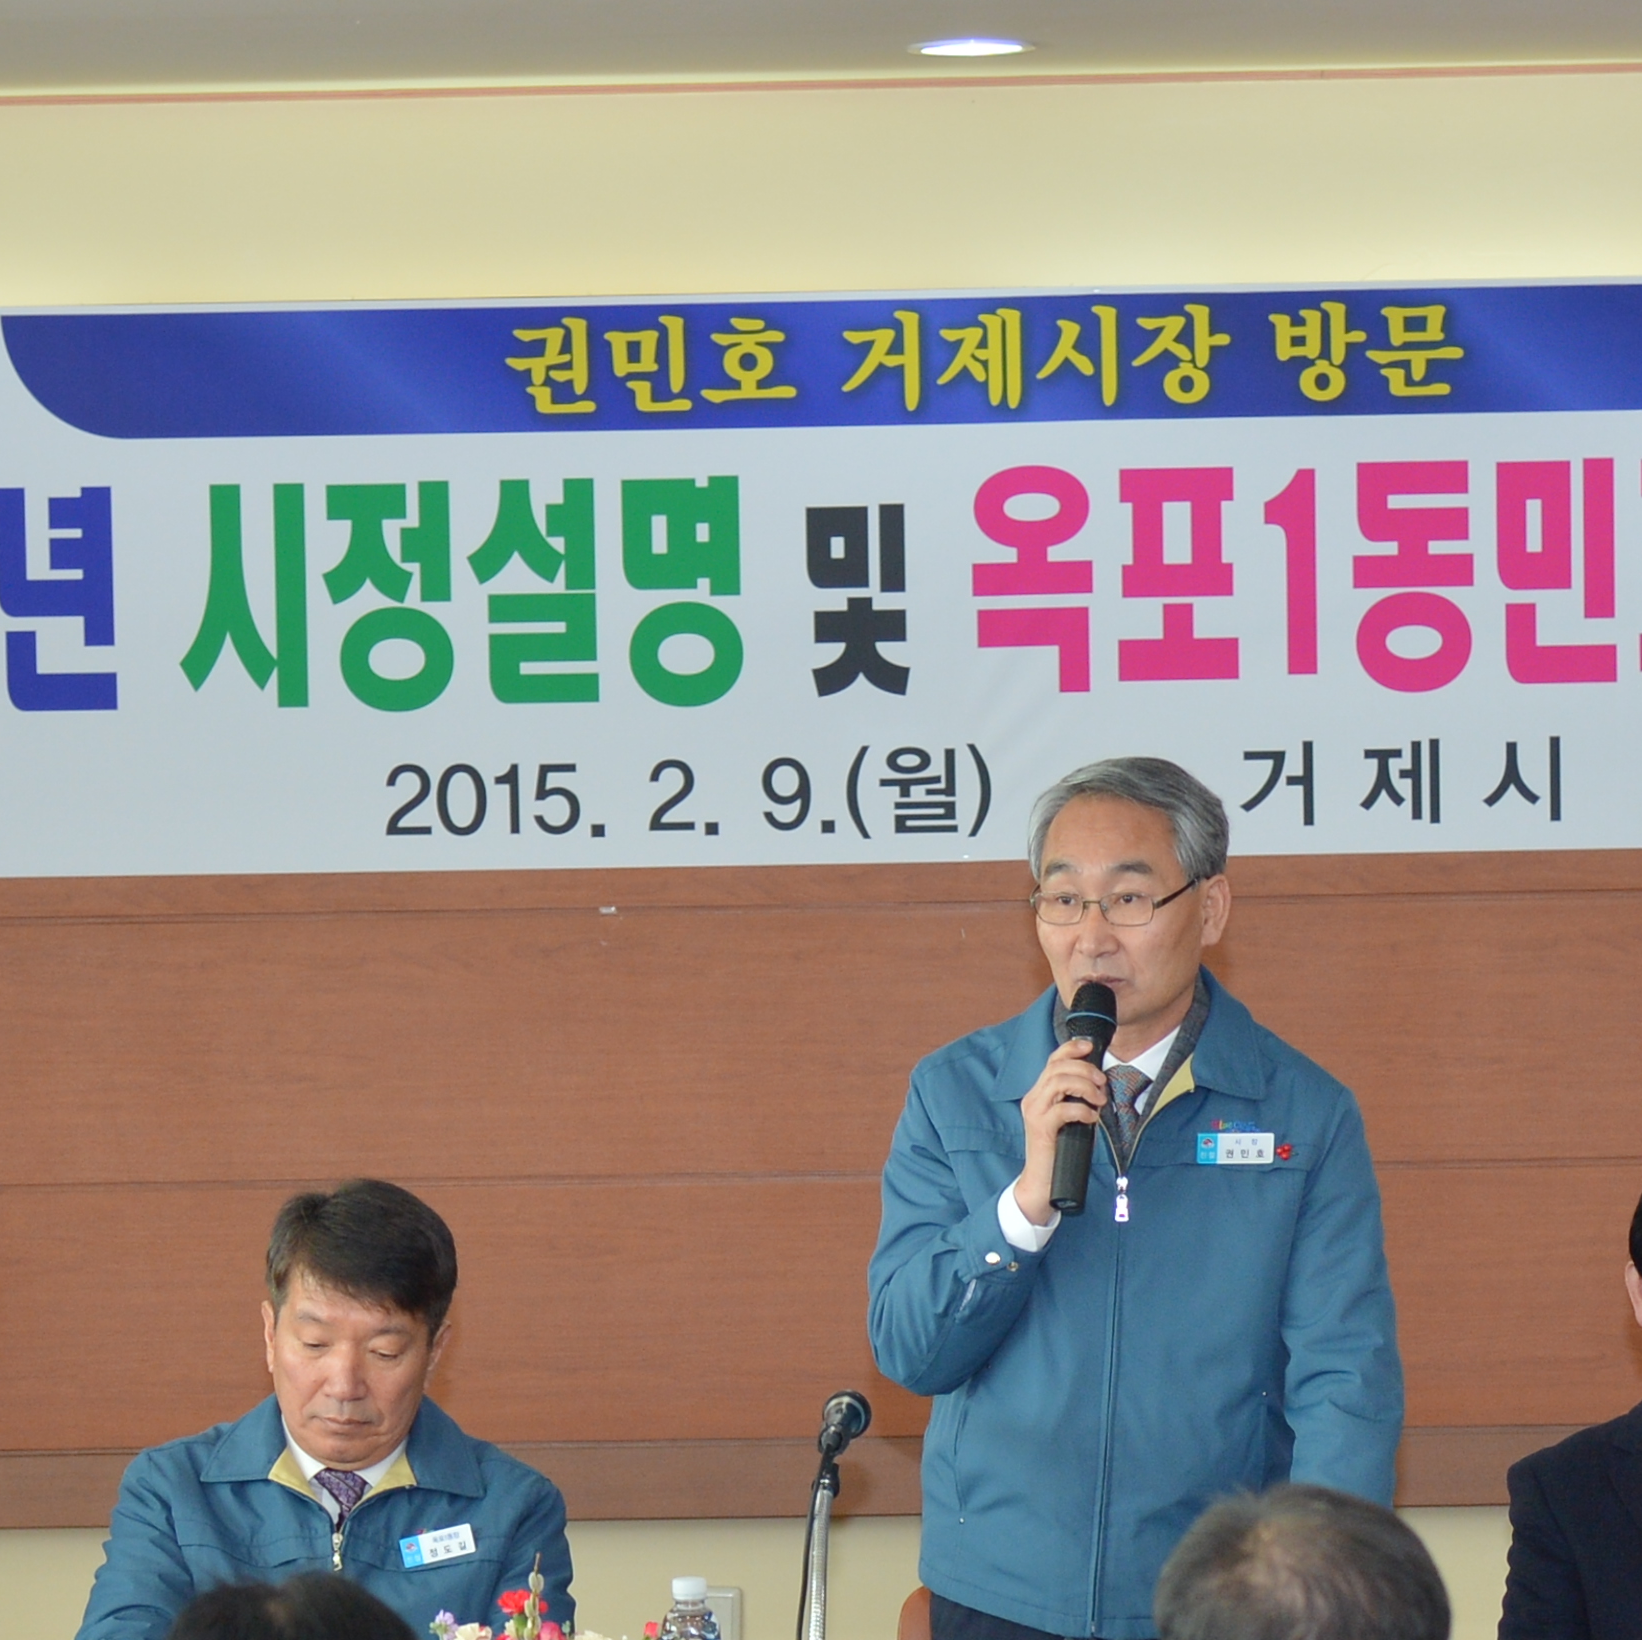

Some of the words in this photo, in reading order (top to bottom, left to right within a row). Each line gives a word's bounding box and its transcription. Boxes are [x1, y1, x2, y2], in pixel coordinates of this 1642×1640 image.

[506, 315, 798, 414] 권민호
[842, 303, 1232, 411] 거제시장
[1269, 301, 1465, 402] 방문
[180, 475, 745, 713] 시정설명
[805, 503, 911, 698] 및
[385, 763, 607, 838] 2015.
[647, 759, 720, 836] 2.
[761, 743, 992, 839] 9.(월)
